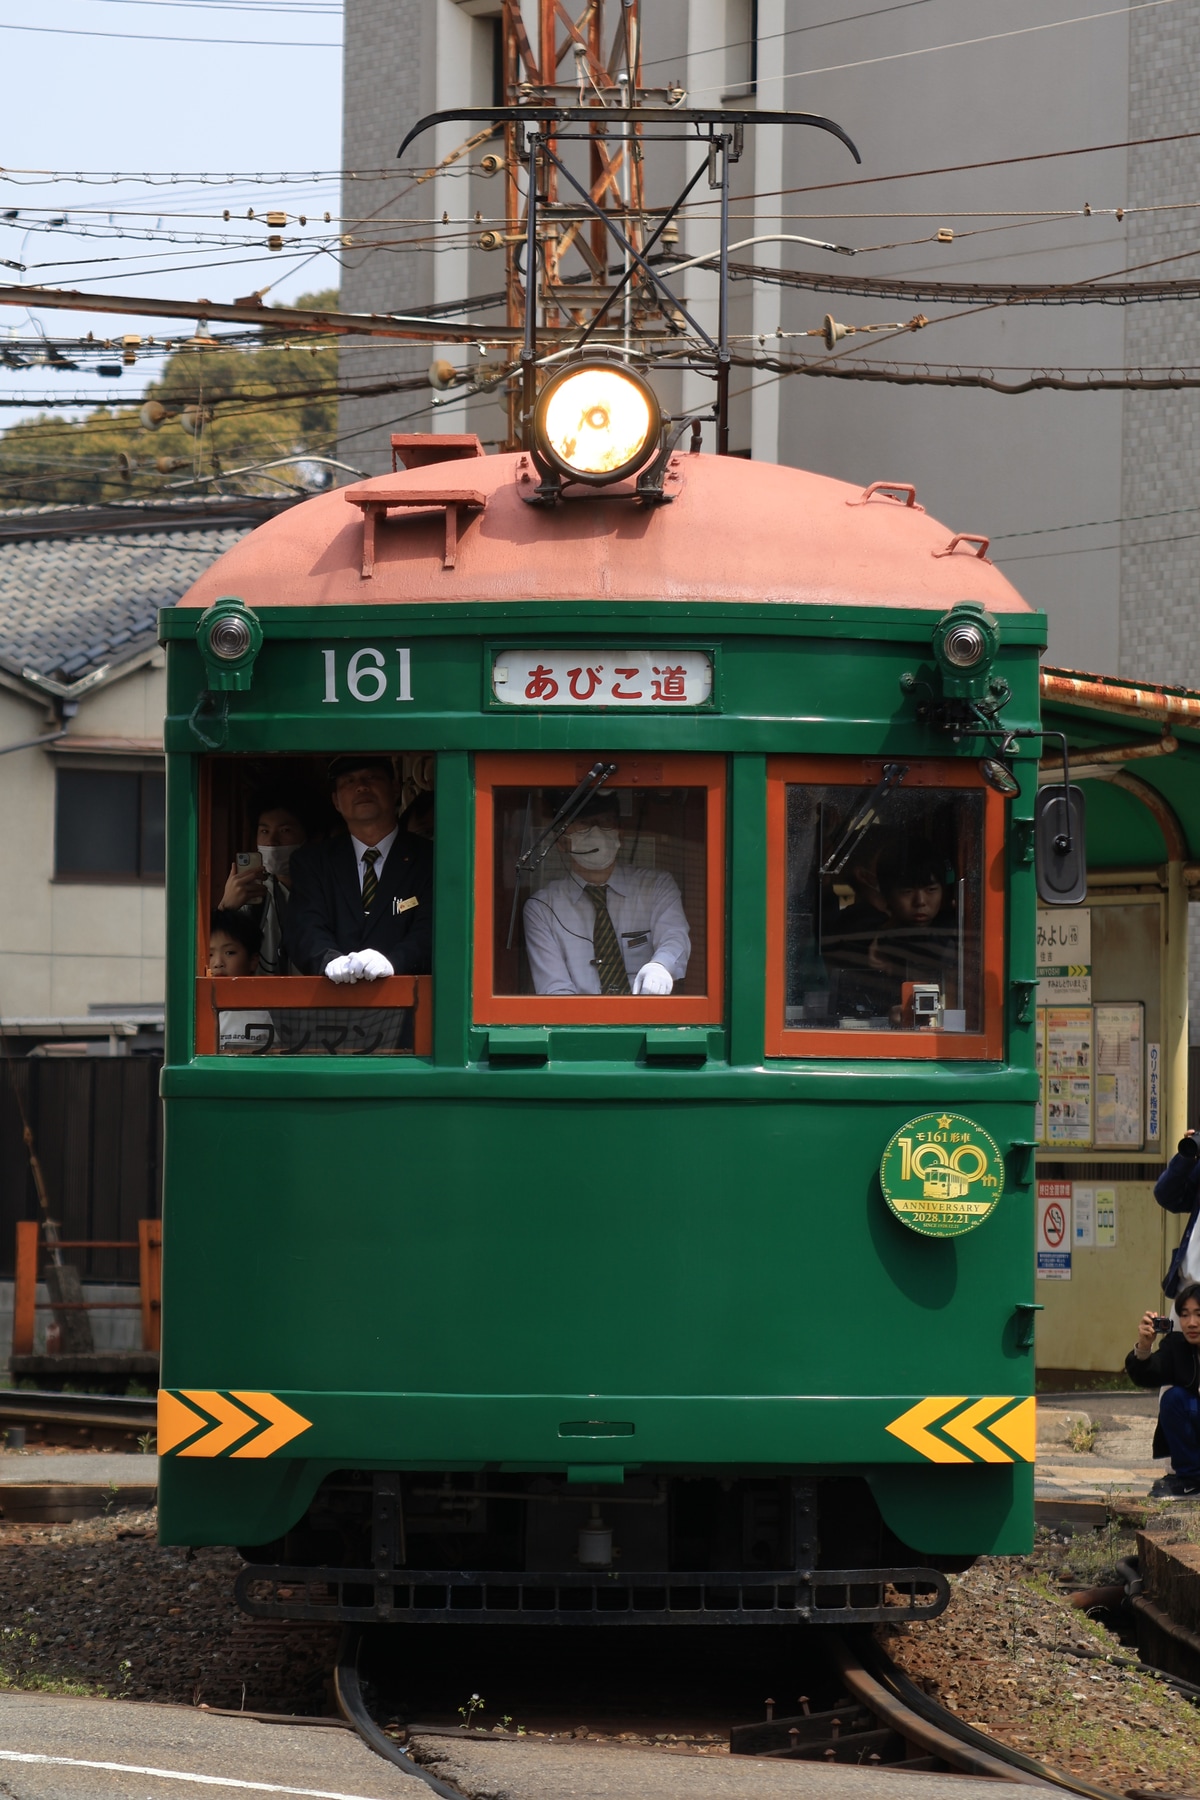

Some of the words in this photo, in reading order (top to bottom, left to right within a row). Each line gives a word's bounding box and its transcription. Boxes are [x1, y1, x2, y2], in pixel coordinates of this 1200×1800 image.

[321, 647, 414, 703] 161
[524, 663, 688, 702] あびこ道
[245, 1023, 384, 1055] ワンマン
[1150, 1048, 1158, 1135] のりかえ指定駅
[902, 1202, 980, 1212] ANNIVERSARY
[912, 1212, 969, 1224] 2028.12.21
